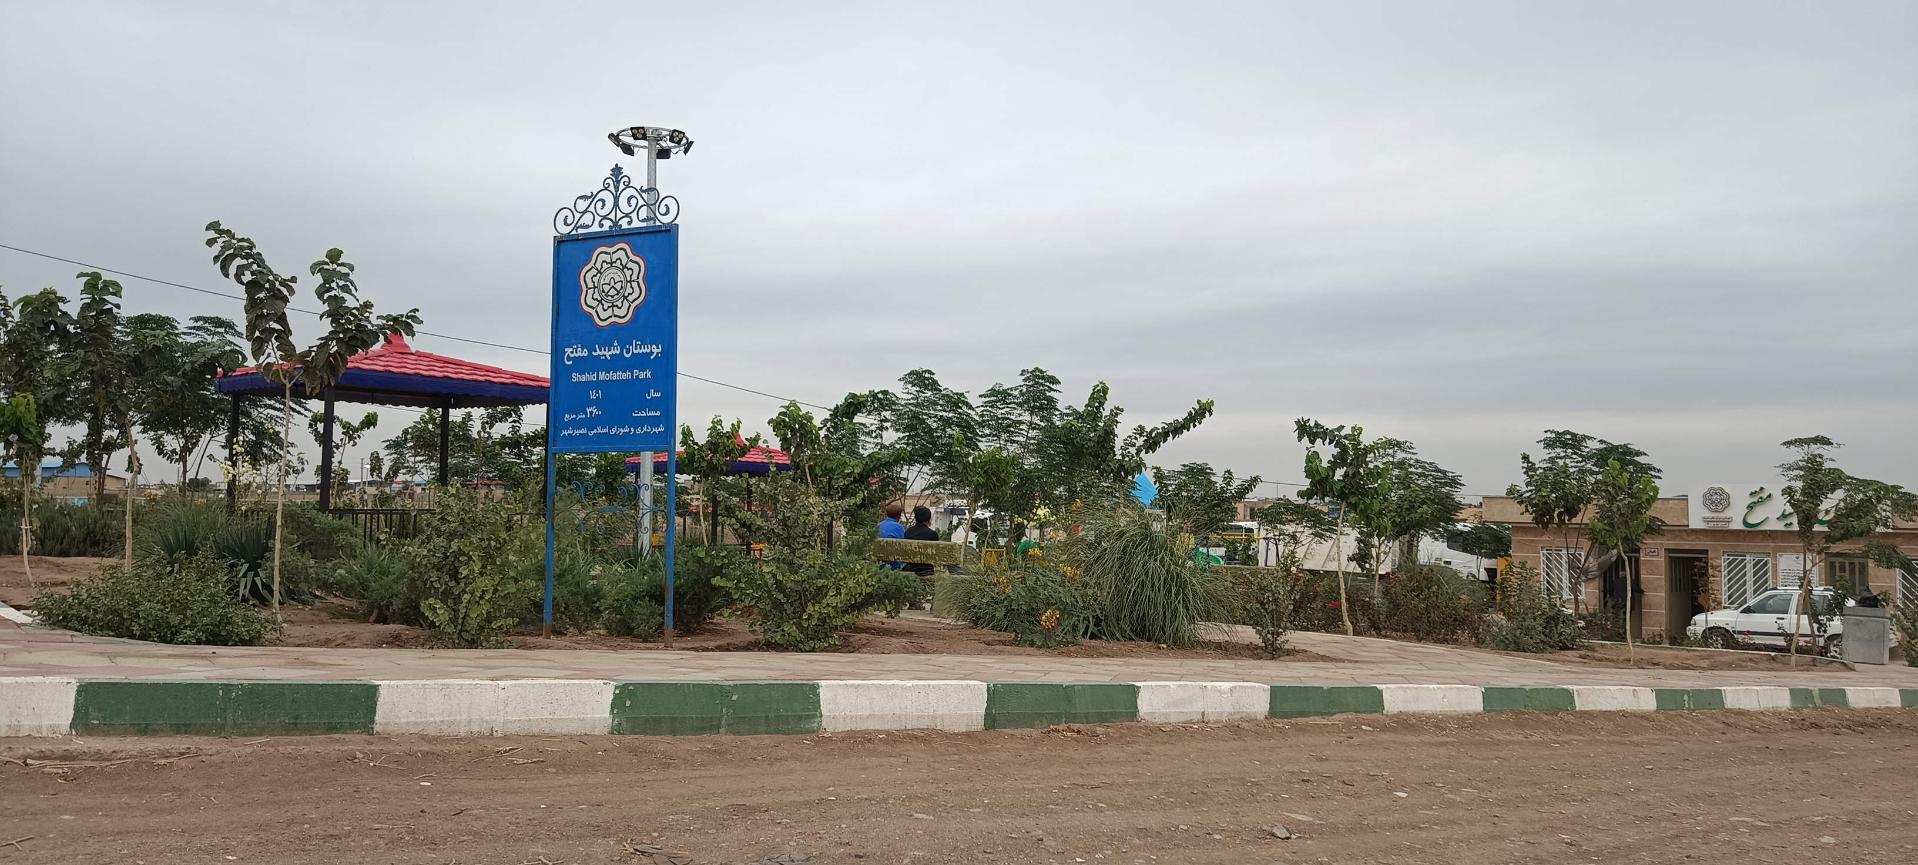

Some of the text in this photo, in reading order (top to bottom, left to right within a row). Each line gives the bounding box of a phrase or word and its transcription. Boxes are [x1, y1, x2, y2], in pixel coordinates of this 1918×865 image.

[564, 340, 662, 365] بوستان شهید مفتح
[571, 369, 651, 382] Shahid Mofatteh Park
[646, 389, 661, 399] سال
[564, 413, 576, 422] مربع
[576, 411, 586, 420] متر
[632, 408, 660, 417] مساحت
[588, 426, 609, 436] اسلامی
[609, 424, 630, 436] شورای
[635, 424, 665, 436] شهرداری
[1742, 486, 1774, 529] مفتح
